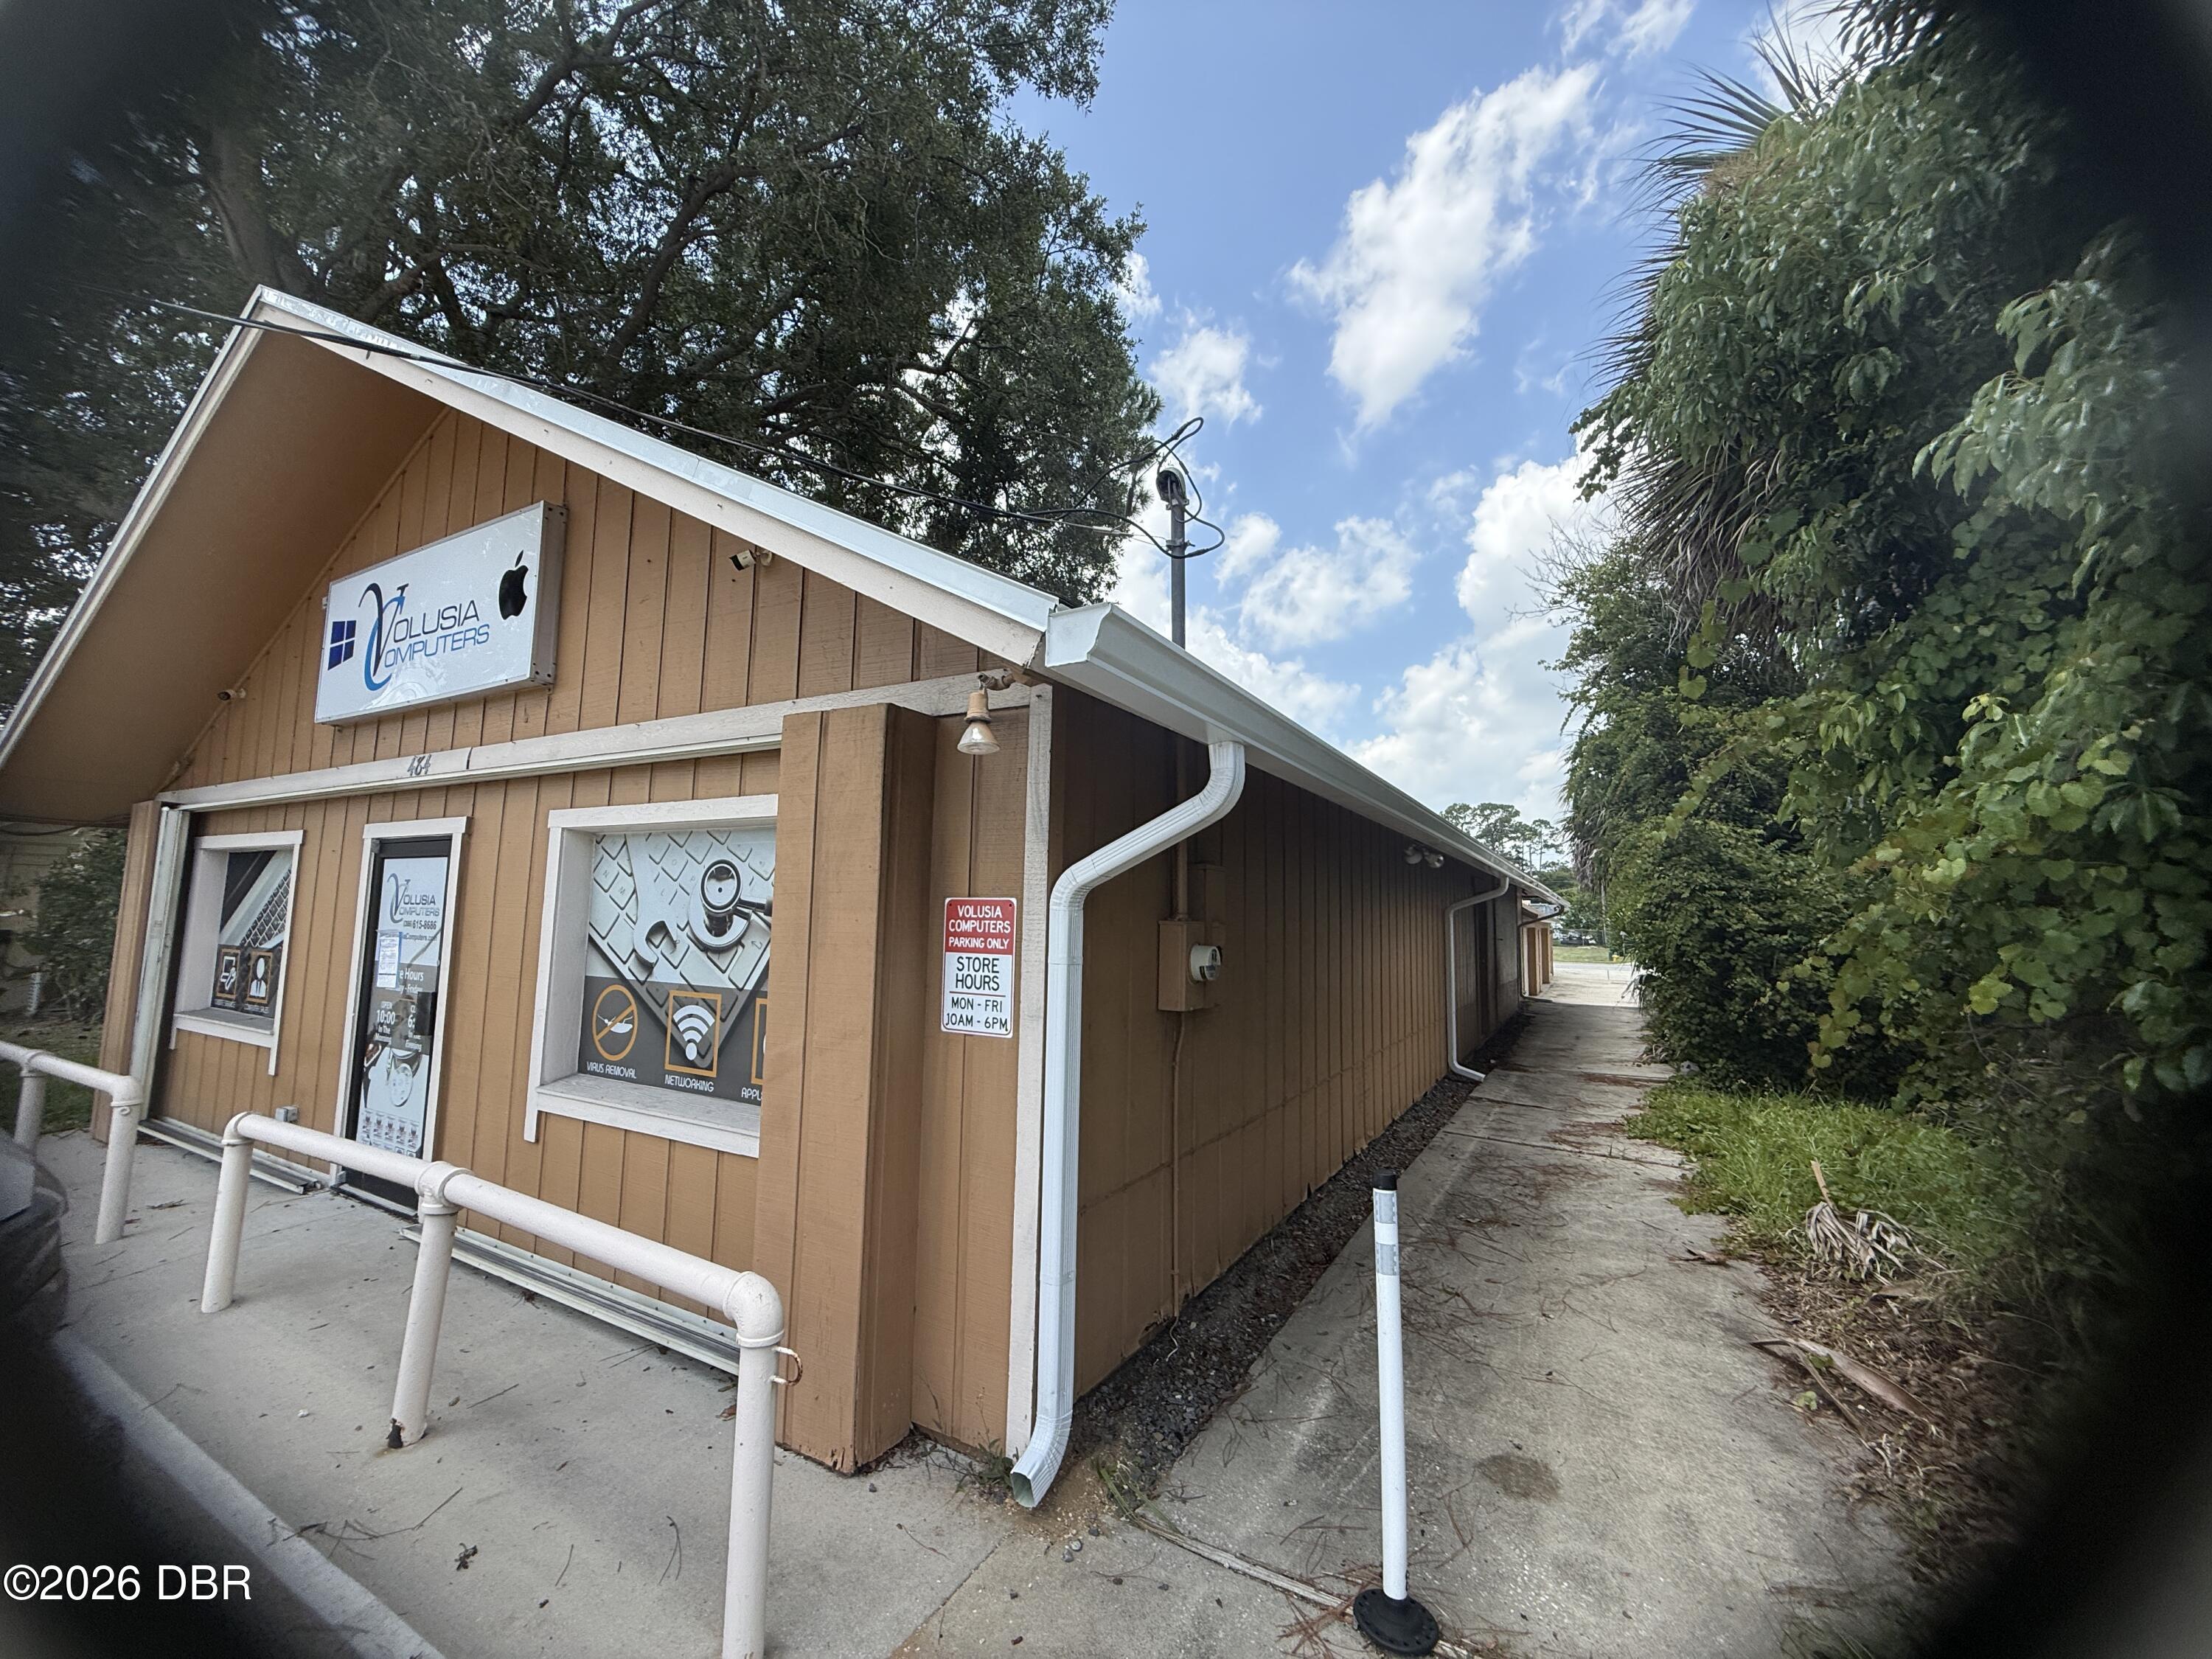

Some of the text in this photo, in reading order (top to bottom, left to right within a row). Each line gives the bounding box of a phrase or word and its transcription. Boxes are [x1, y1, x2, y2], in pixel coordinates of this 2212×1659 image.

[358, 582, 480, 676] VOLUSIA
[364, 596, 490, 691] COMPUTERS
[957, 905, 1003, 919] VOLUSIA
[948, 919, 1011, 933] COMPUTERS
[948, 936, 1009, 950] PARKING ONLY
[956, 956, 1000, 974] STORE
[404, 967, 424, 981] Hours
[955, 973, 1000, 992] HOURS
[951, 996, 974, 1011] MON
[984, 999, 1003, 1013] FRI
[377, 1009, 396, 1025] 10:00
[984, 1016, 1009, 1032] 6PM
[586, 1061, 637, 1079] VIRUS REMOVAL
[664, 1074, 714, 1093] NETWORKING
[741, 1087, 762, 1102] APPL
